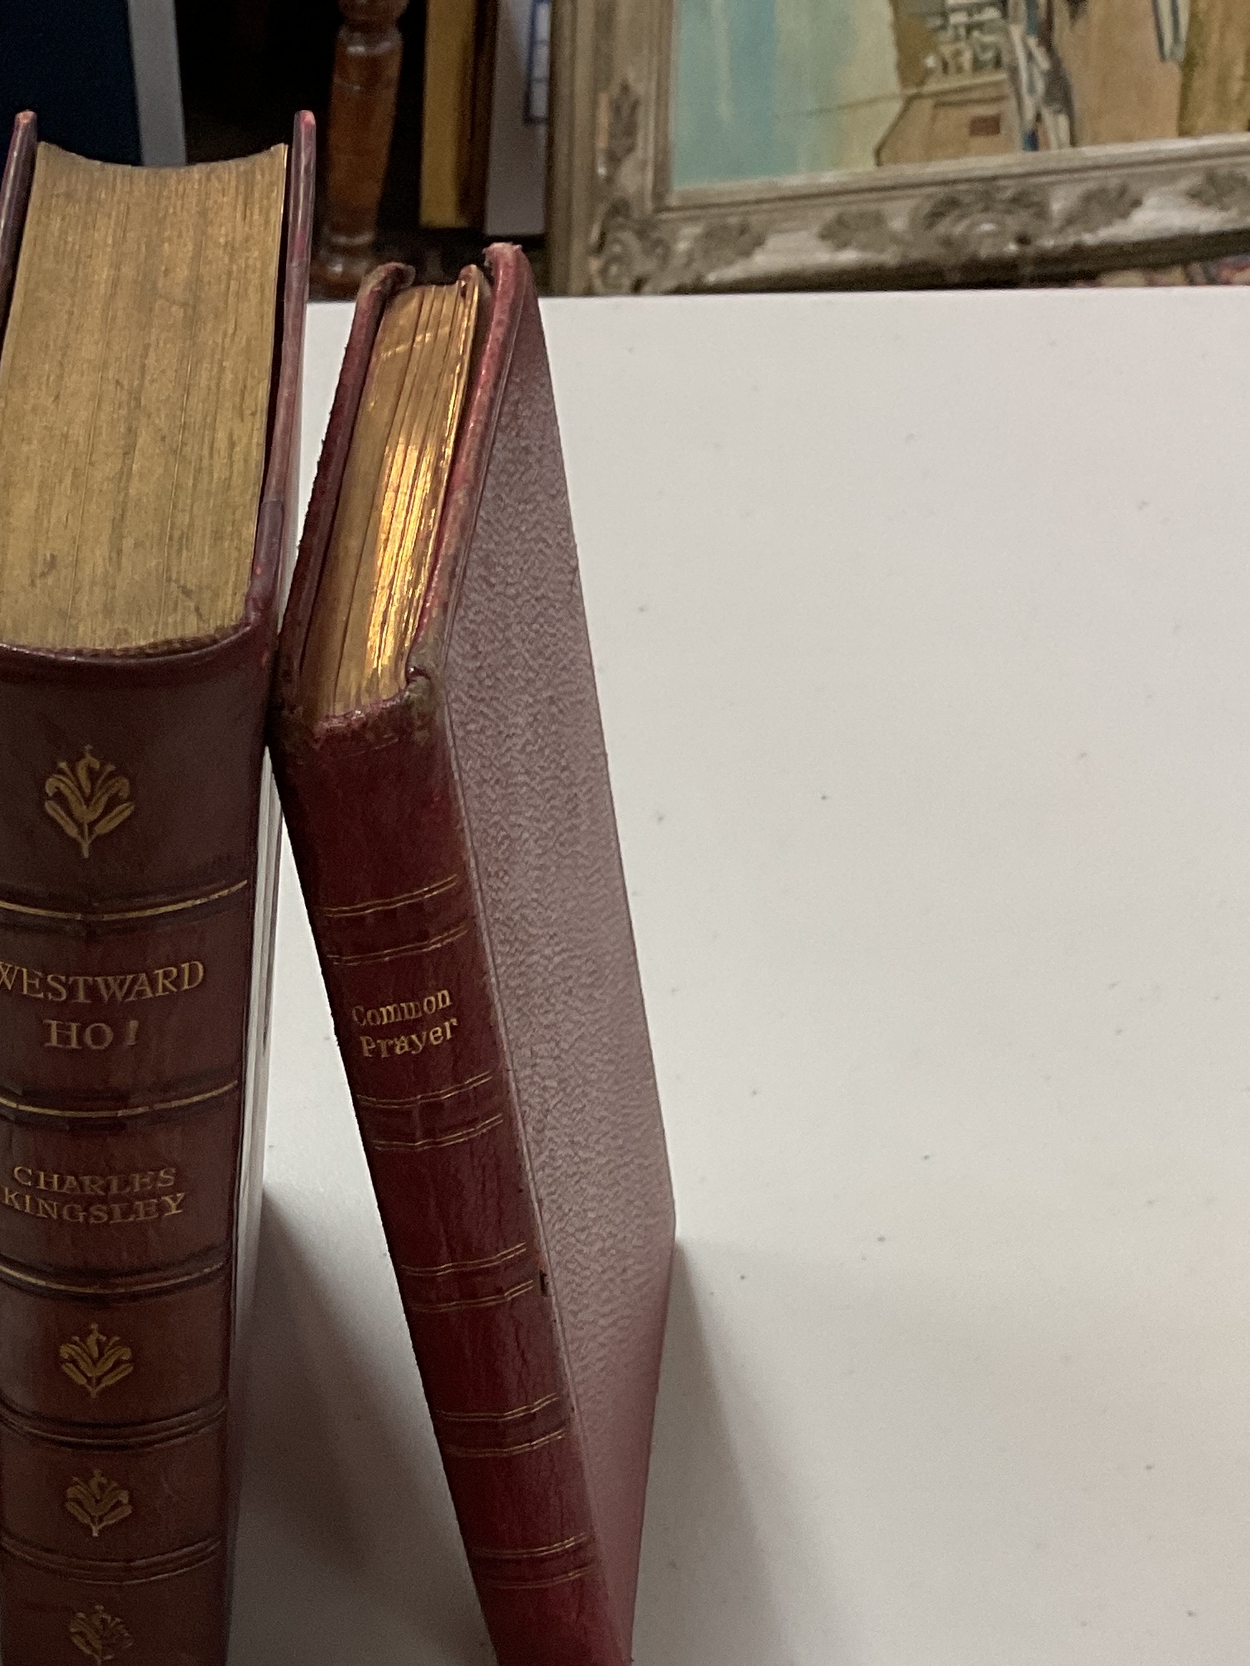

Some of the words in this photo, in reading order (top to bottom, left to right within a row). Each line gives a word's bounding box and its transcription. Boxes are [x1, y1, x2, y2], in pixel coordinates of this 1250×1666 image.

[352, 989, 453, 1026] Common
[359, 1018, 458, 1058] Prayer
[13, 1166, 176, 1196] CHARLES
[2, 1186, 186, 1225] KINGSLEY
